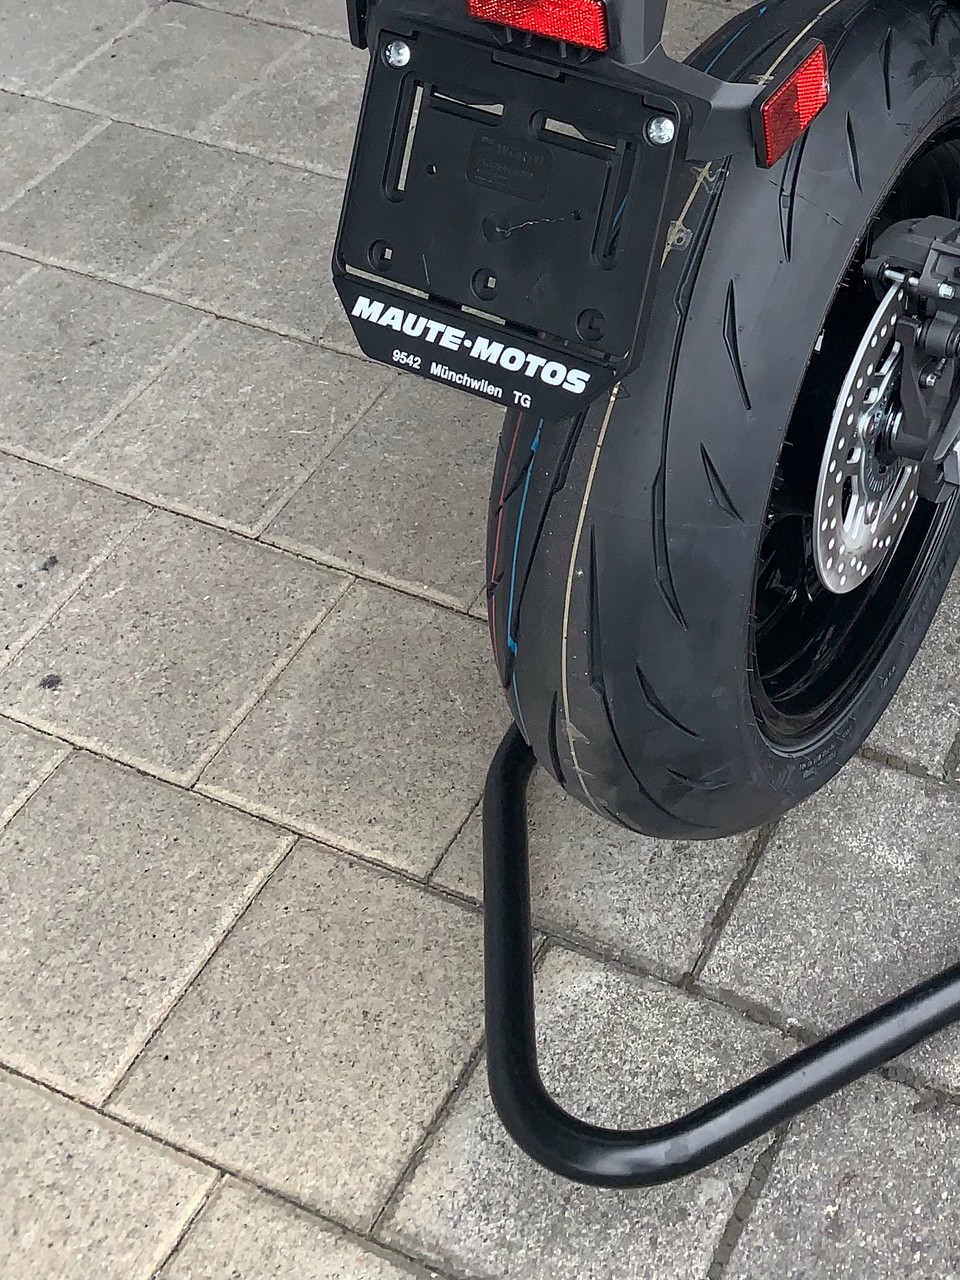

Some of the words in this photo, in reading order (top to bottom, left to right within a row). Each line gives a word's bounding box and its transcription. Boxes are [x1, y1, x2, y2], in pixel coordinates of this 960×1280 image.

[392, 349, 422, 370] 9542
[430, 362, 503, 399] Münchwilen
[512, 390, 532, 408] TG
